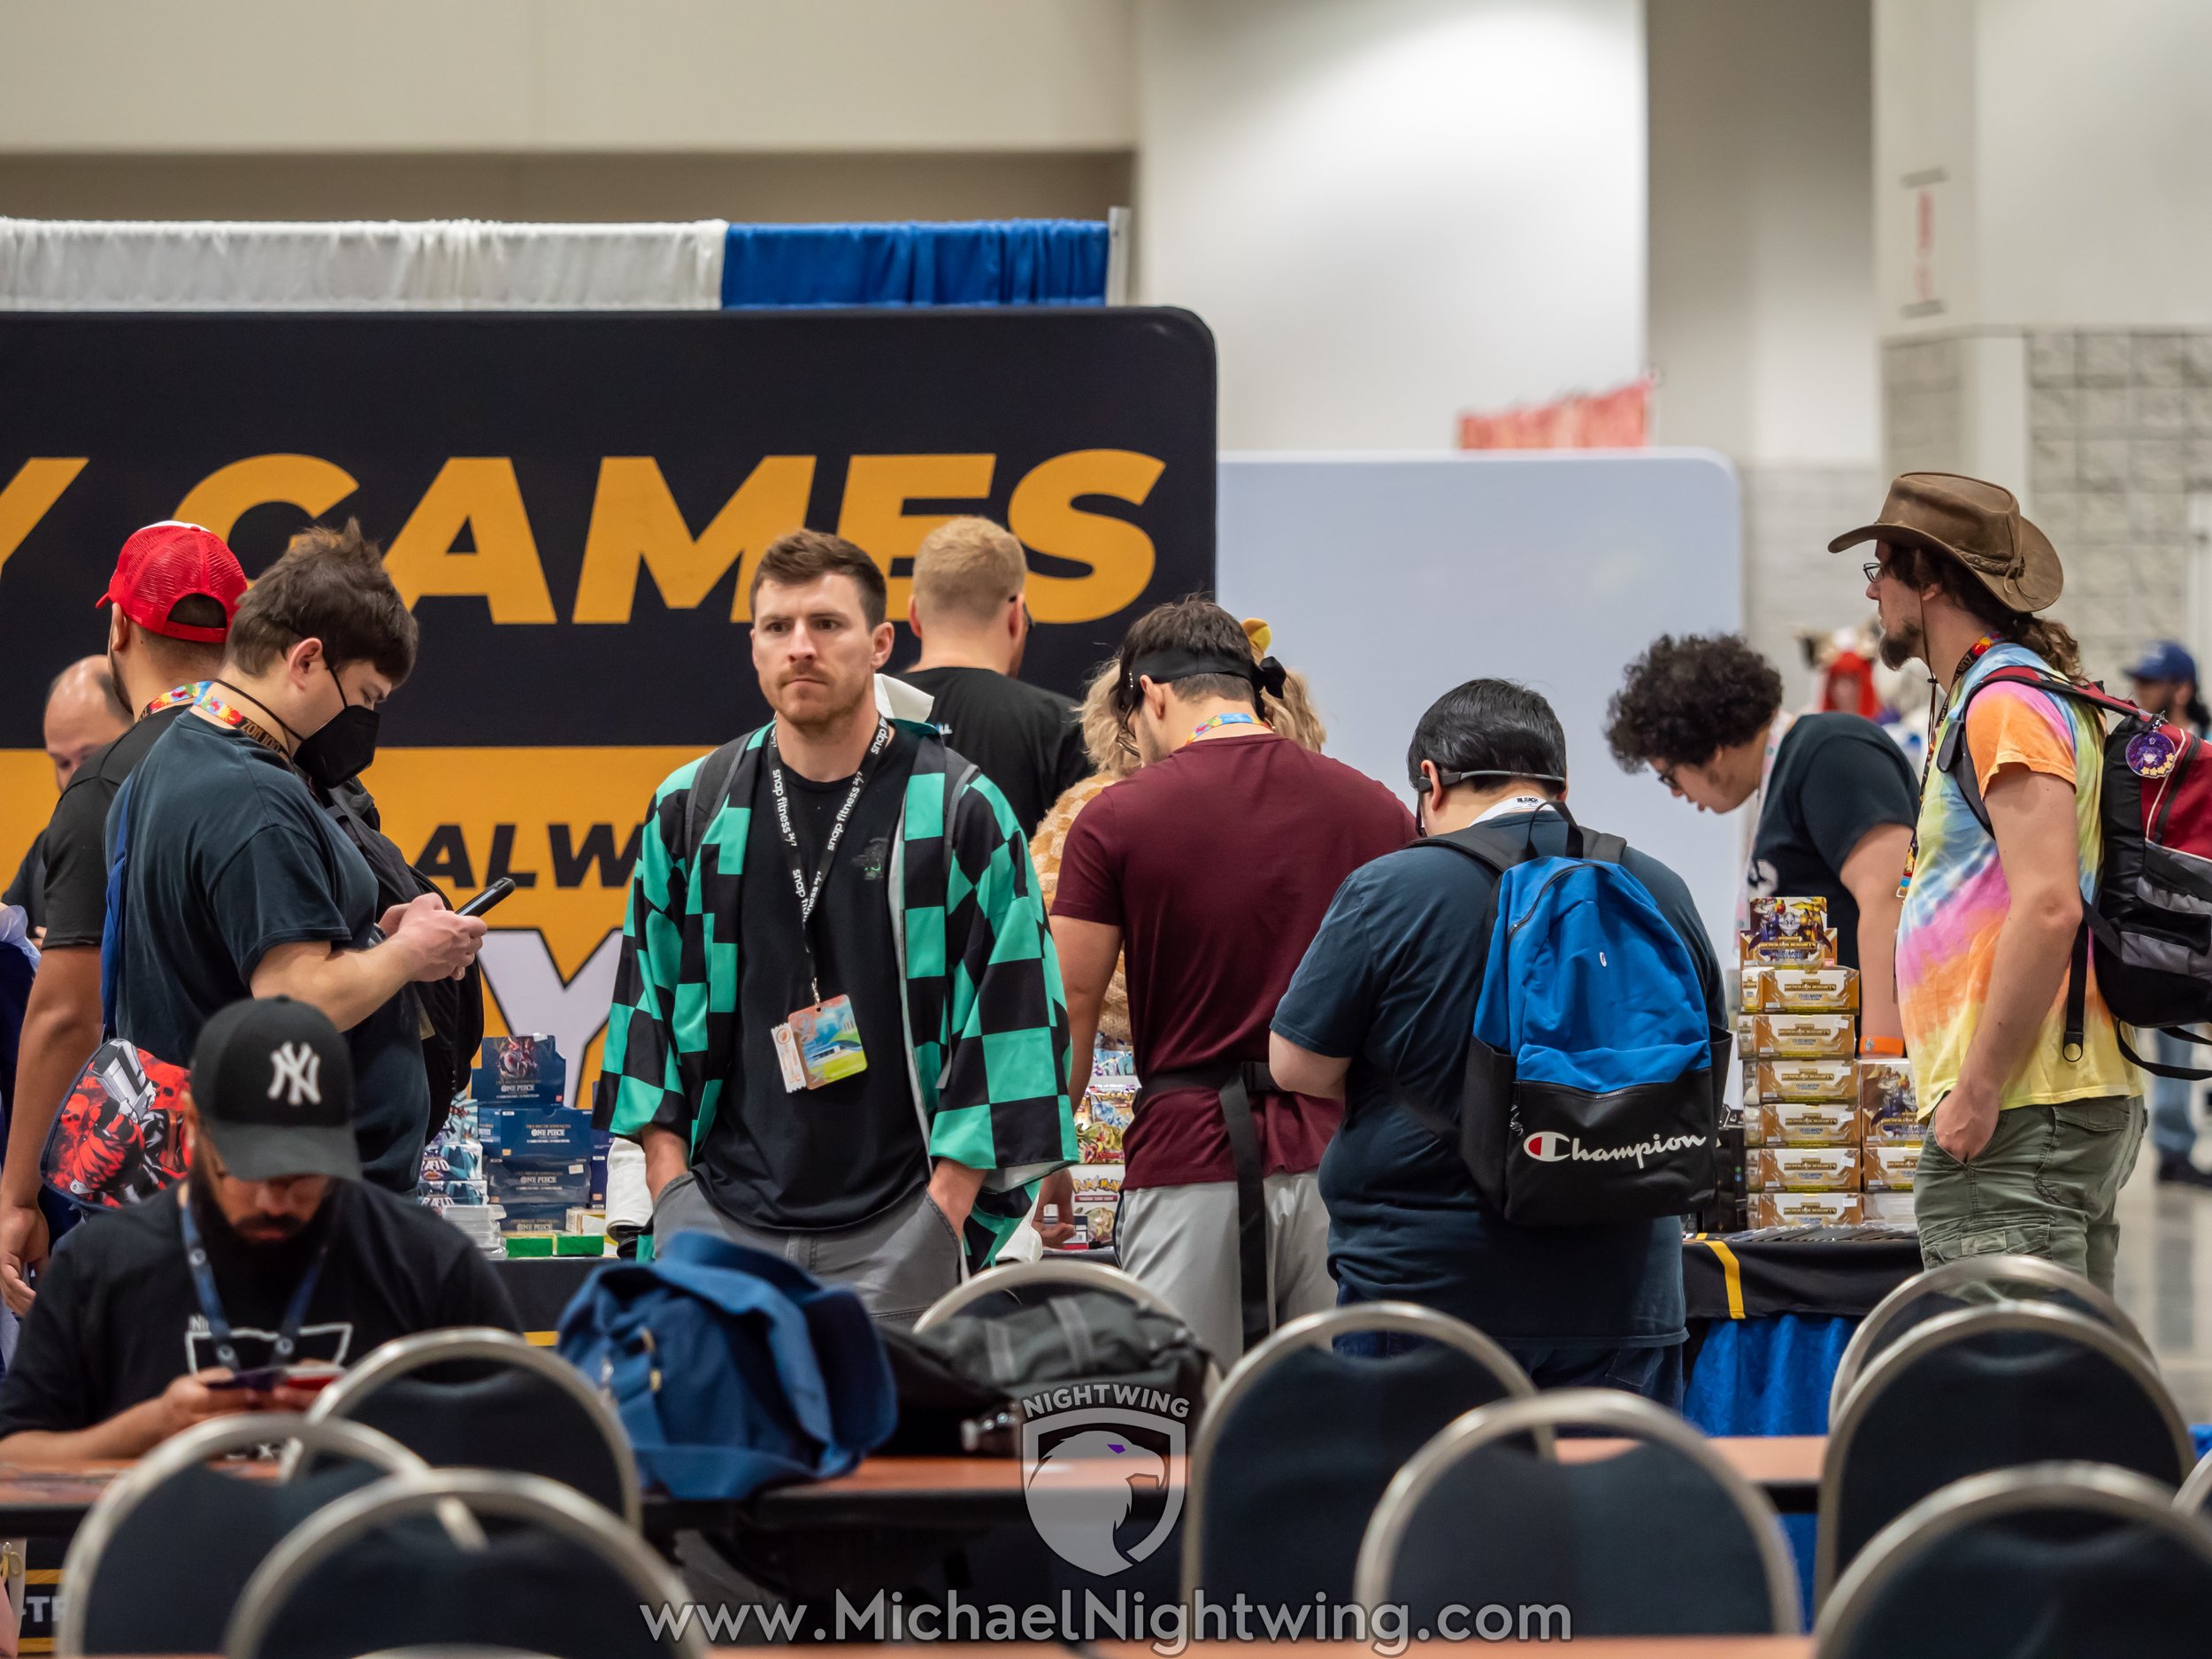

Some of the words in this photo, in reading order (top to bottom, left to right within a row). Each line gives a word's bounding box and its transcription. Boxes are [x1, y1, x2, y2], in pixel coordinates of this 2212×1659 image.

[171, 449, 1167, 625] GAMES
[772, 768, 784, 796] snap
[777, 796, 791, 833] fitness
[827, 823, 843, 851] snap
[836, 787, 860, 822] fitness
[413, 822, 644, 888] ALW
[792, 869, 806, 898] snap
[267, 1041, 321, 1104] NY
[1524, 1132, 1706, 1169] Champion
